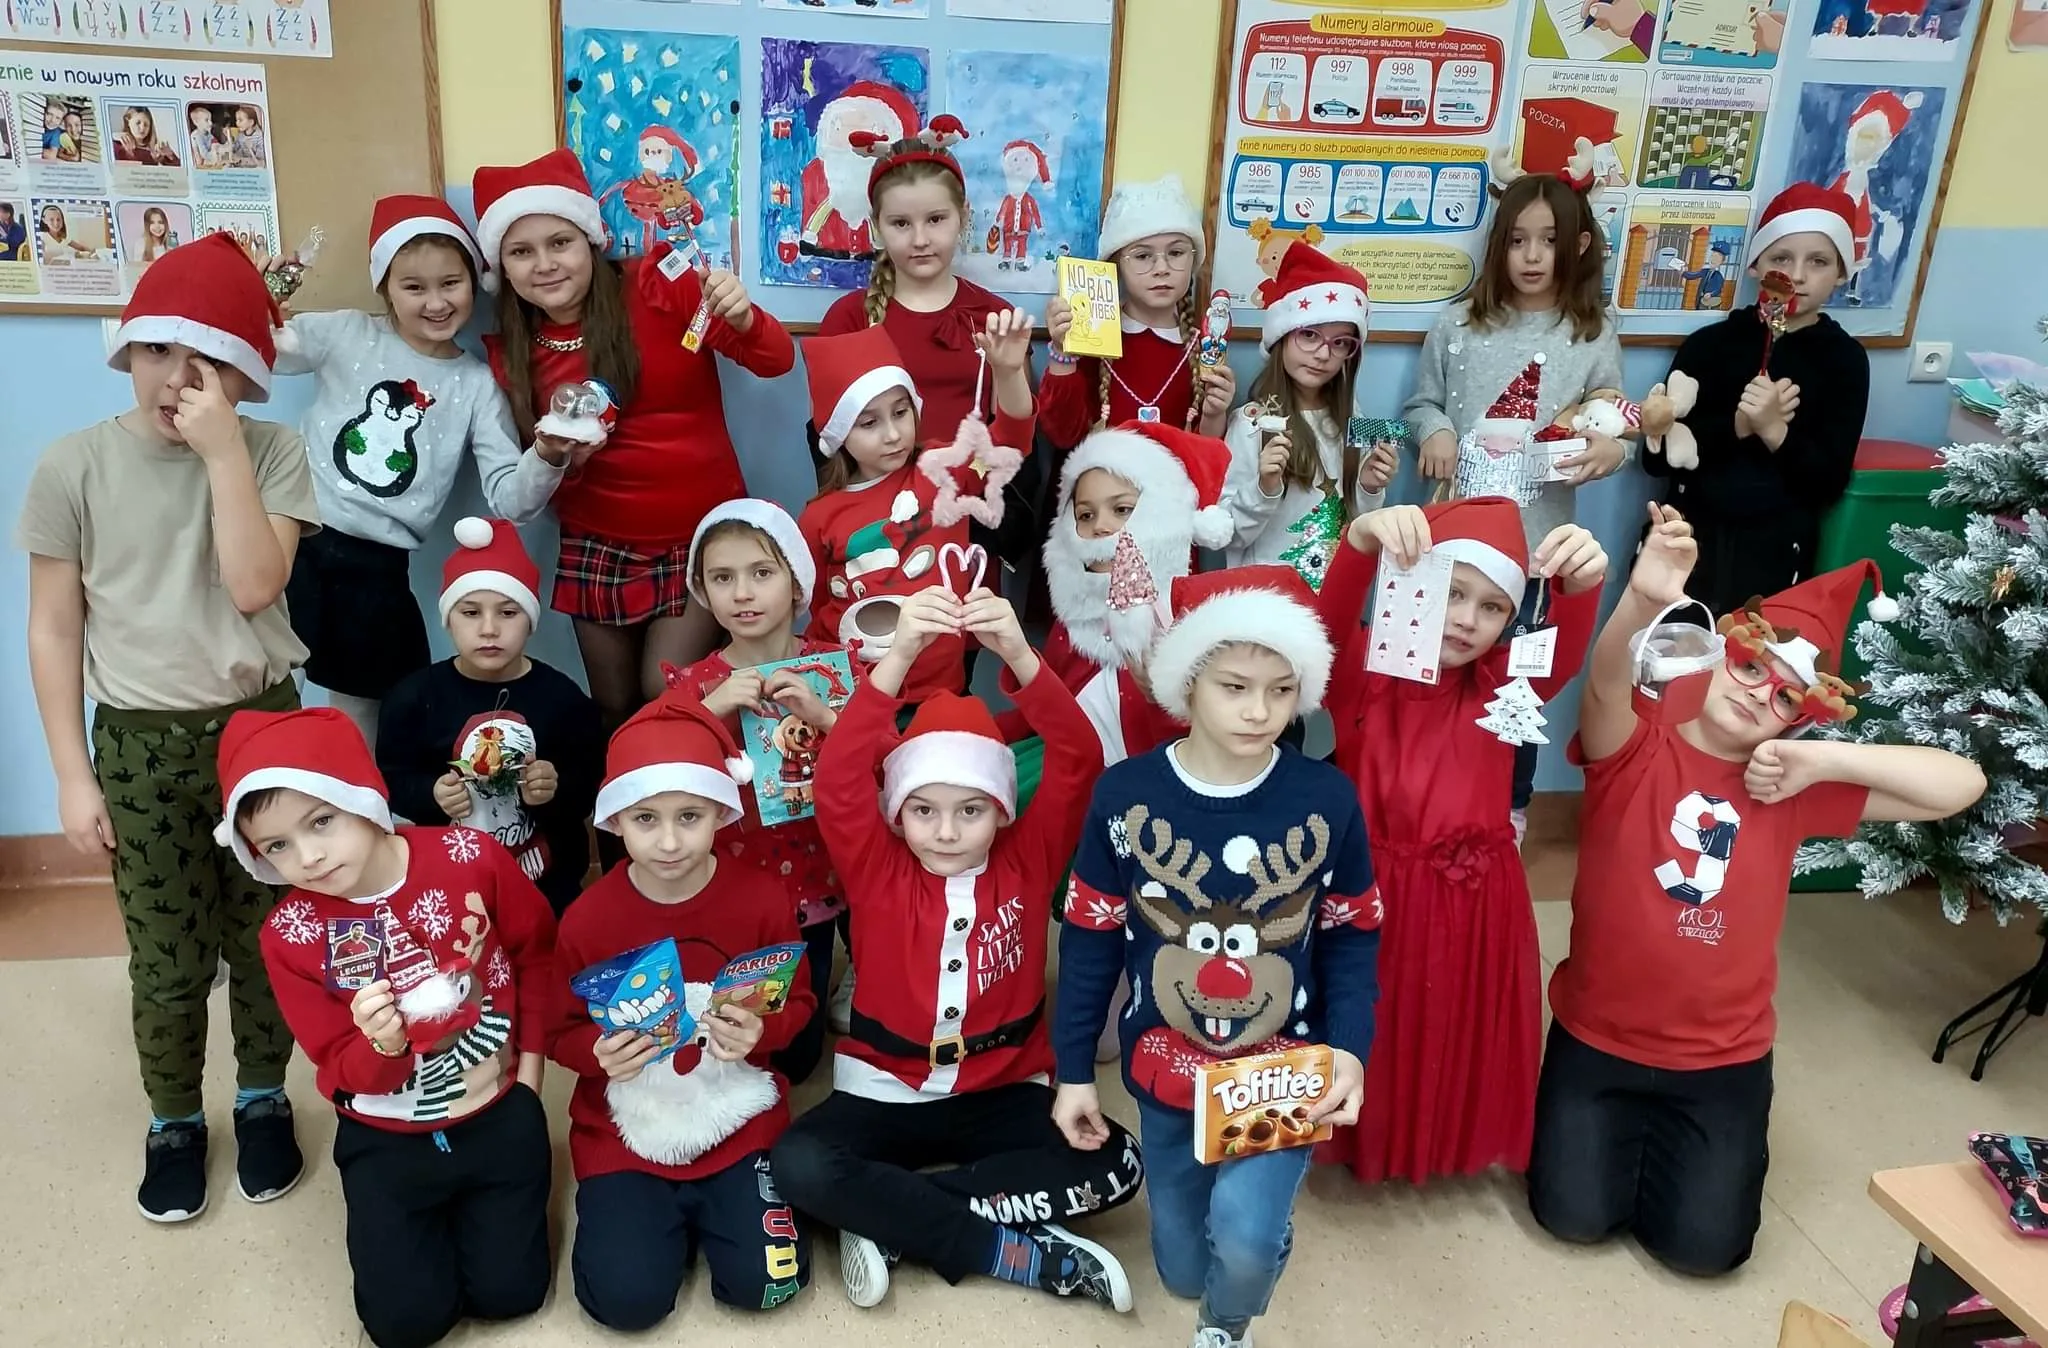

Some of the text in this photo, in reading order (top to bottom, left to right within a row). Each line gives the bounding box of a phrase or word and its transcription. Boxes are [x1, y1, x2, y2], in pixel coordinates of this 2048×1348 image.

[1320, 14, 1434, 34] Numery alarmowe
[1260, 32, 1290, 45] Numery
[1292, 34, 1324, 45] telefonu
[1270, 57, 1287, 71] 112
[1330, 59, 1353, 73] 997
[1391, 62, 1415, 76] 998
[1453, 65, 1477, 78] 999
[1552, 70, 1619, 82] Wrzucenie listu do
[1661, 71, 1701, 82] Sortowanie
[1726, 75, 1736, 83] na
[41, 68, 57, 82] w
[65, 69, 131, 87] nowym
[138, 68, 177, 89] roku
[183, 71, 263, 94] szkolnym
[1547, 82, 1618, 96] skrzynki pocztowej
[1529, 107, 1566, 132] POCZTA
[1239, 139, 1260, 151] Inne
[1262, 143, 1297, 154] numery
[1299, 142, 1312, 152] do
[1395, 145, 1408, 155] do
[1410, 147, 1449, 157] niesienia
[1450, 148, 1487, 160] pomocy
[1248, 163, 1272, 177] 986
[1299, 165, 1321, 179] 985
[1660, 198, 1722, 209] Dostarczenie listu
[1067, 263, 1086, 288] NO
[1086, 277, 1114, 303] BAD
[1088, 302, 1116, 321] VIBES
[339, 961, 377, 977] LEGEND
[724, 950, 794, 978] HARIBO
[1212, 1063, 1326, 1117] Toffifee
